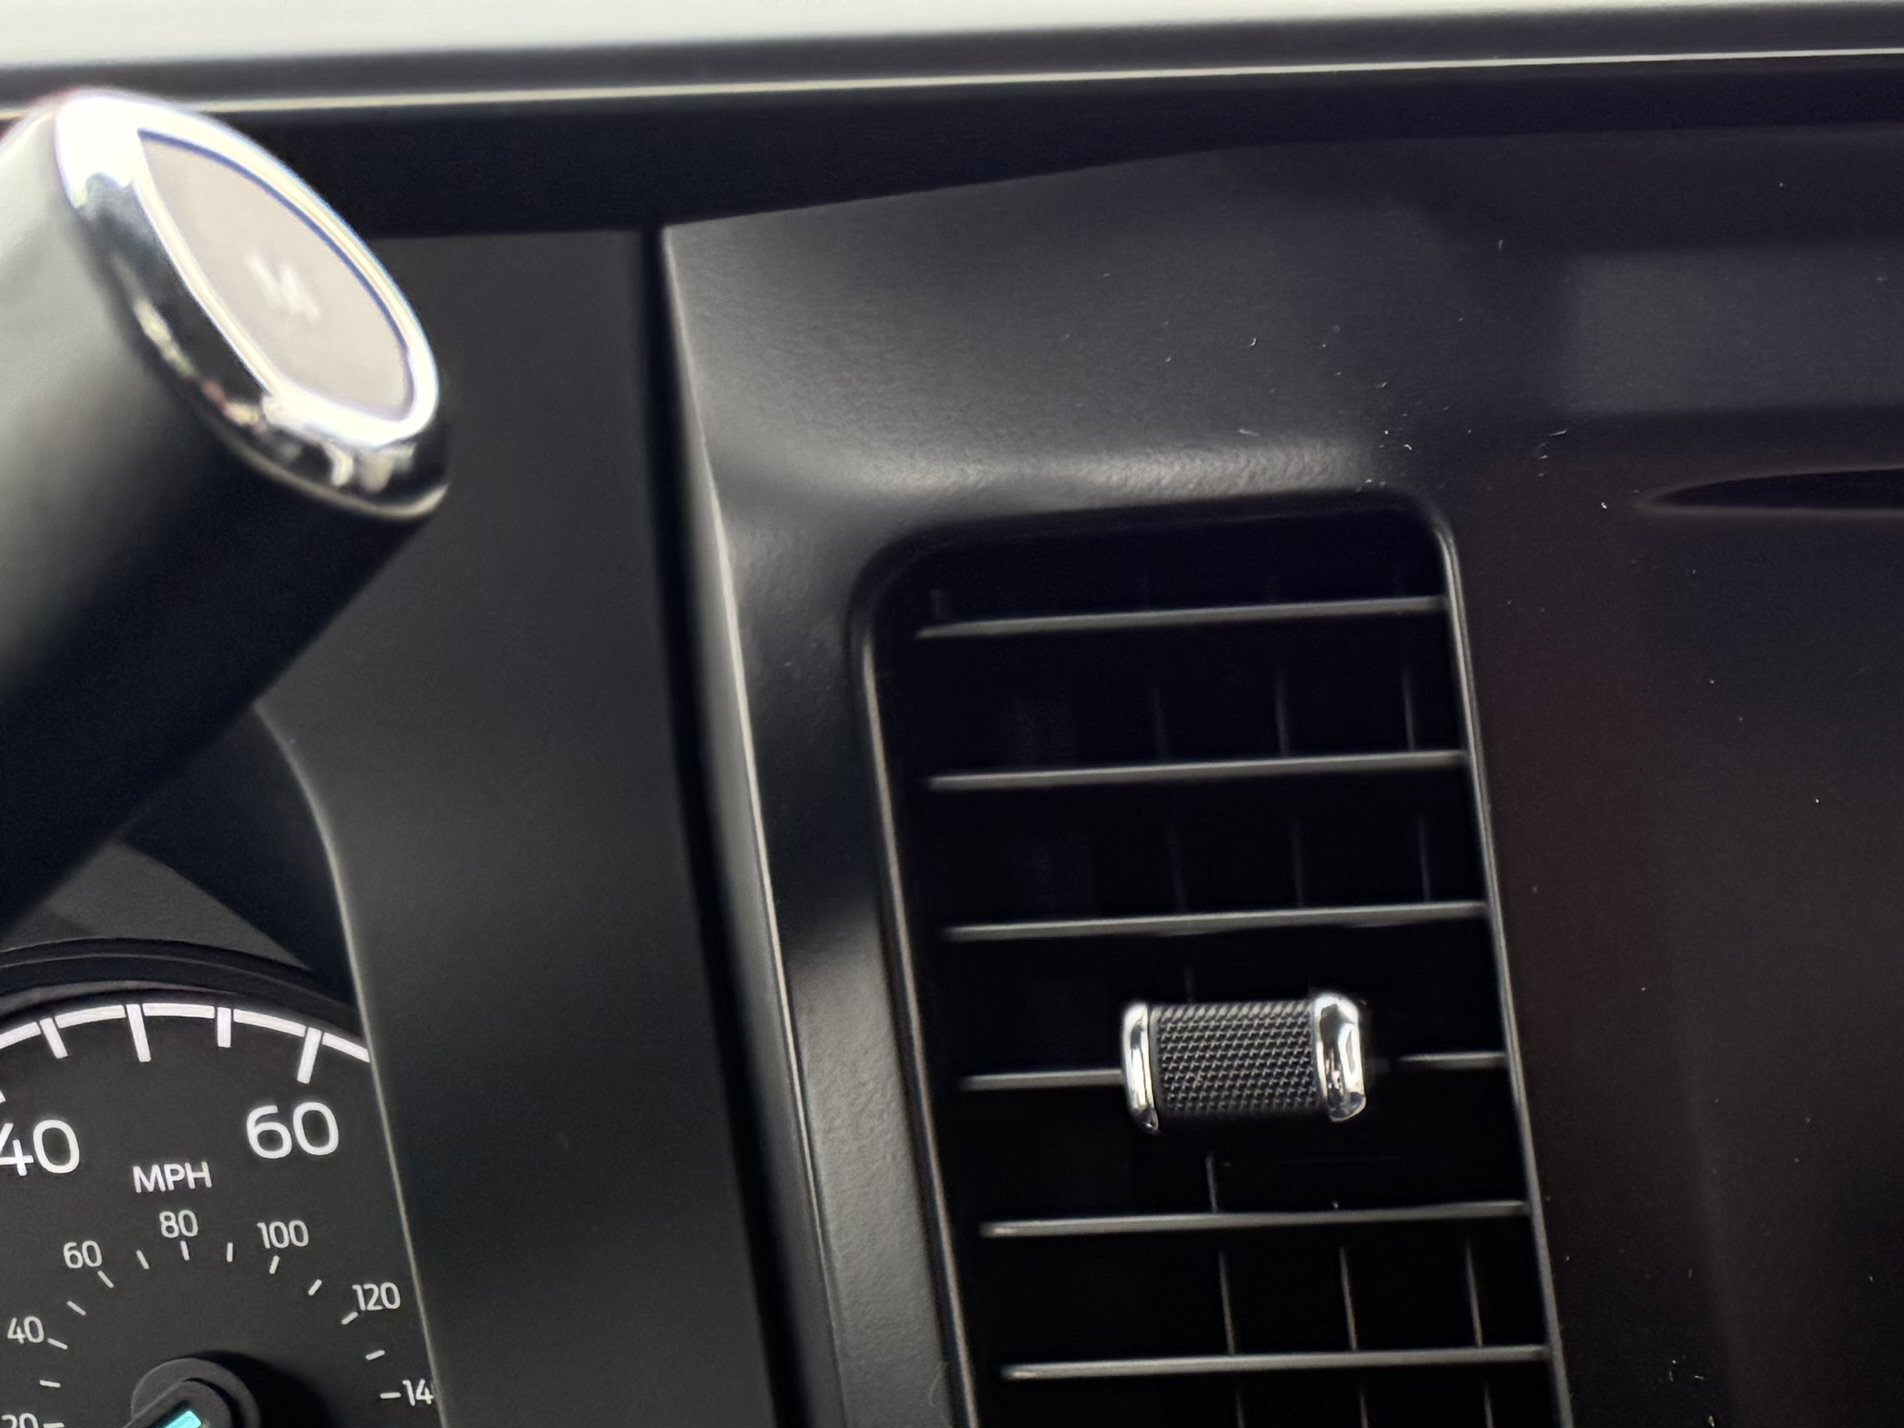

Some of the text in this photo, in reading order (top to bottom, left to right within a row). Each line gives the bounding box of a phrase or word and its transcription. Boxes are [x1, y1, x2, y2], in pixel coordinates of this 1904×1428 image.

[245, 1100, 340, 1160] 60
[0, 1119, 81, 1177] 40
[132, 1161, 212, 1193] MPH
[158, 1208, 199, 1239] 80
[256, 1219, 310, 1249] 100
[62, 1239, 103, 1270] 60
[352, 1281, 402, 1312] 120
[6, 1315, 45, 1344] 40
